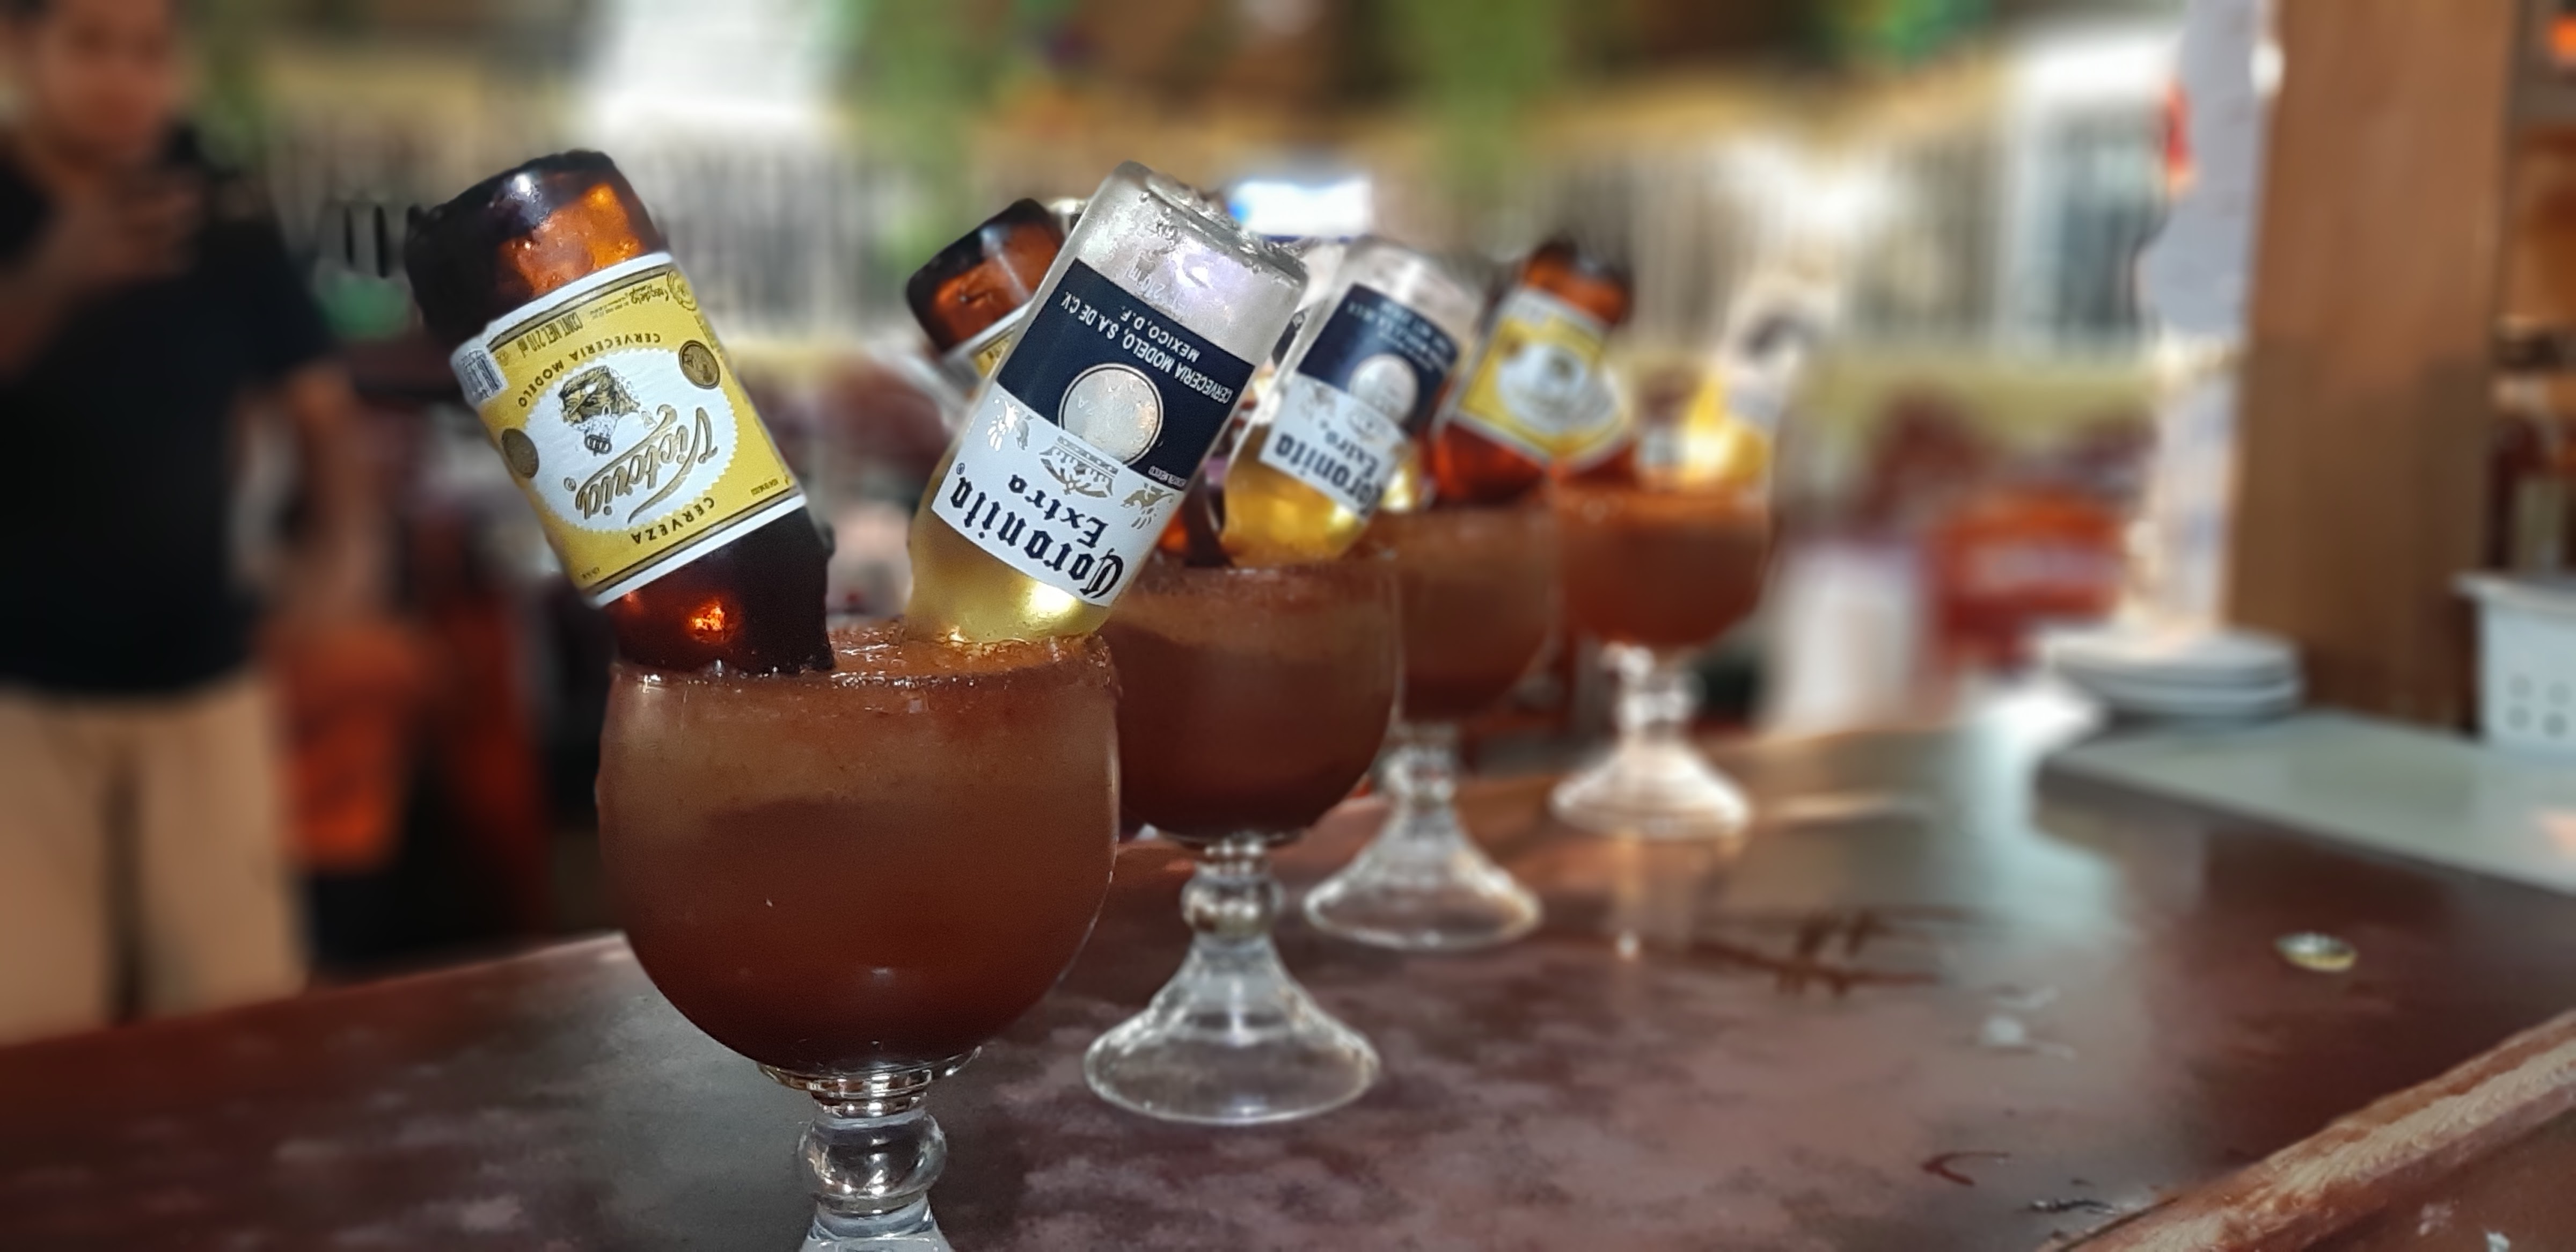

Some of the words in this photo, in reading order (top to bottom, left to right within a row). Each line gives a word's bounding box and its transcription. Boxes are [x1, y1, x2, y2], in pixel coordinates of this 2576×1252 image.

[1061, 291, 1081, 315] C.V.
[1078, 304, 1098, 326] DE
[568, 332, 661, 362] CERVECERIA
[1099, 314, 1119, 340] S.A.
[1148, 319, 1201, 363] MEXICO,
[1122, 328, 1175, 374] MODELO,
[518, 363, 565, 408] MODELO
[1174, 362, 1233, 404] CERVECERIA
[575, 404, 718, 525] Victoria
[631, 497, 715, 545] CERVEZA
[1008, 474, 1109, 549] Extra
[950, 476, 1124, 599] Coronita
